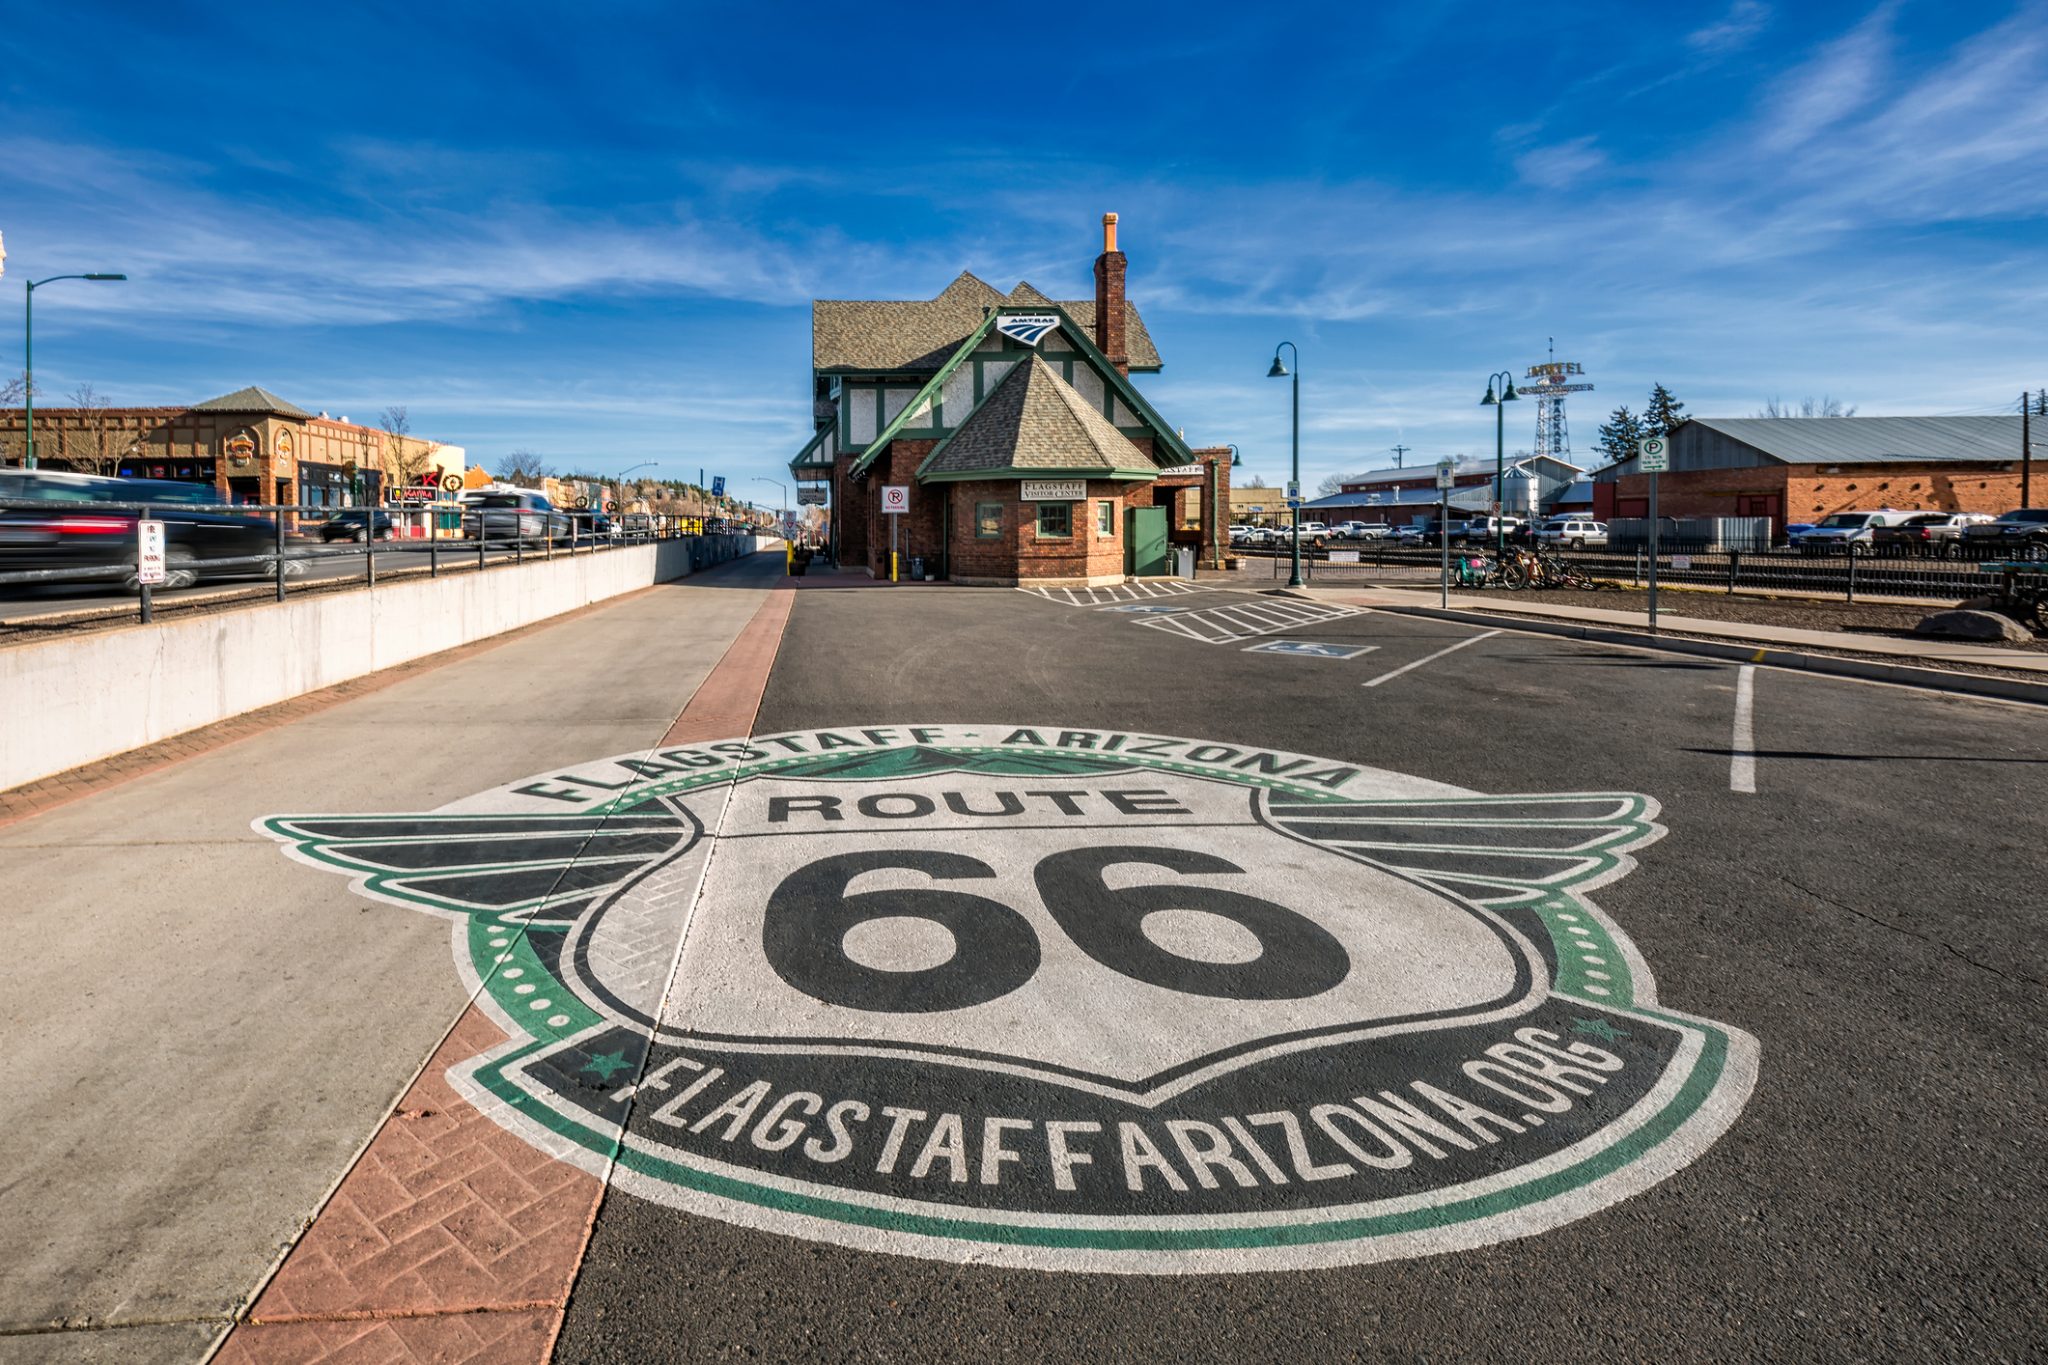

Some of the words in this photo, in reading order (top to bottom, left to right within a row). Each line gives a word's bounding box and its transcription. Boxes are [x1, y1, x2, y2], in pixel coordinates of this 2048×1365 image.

[1649, 442, 1658, 451] P
[1024, 482, 1082, 490] FLAGSTAFF
[1024, 490, 1053, 498] VISITOR
[510, 727, 945, 803] FLAGSTAFF
[1001, 729, 1362, 789] ARIZONA
[768, 790, 1193, 822] ROUTE
[762, 846, 1351, 1013] 66
[610, 1027, 1625, 1192] FLAGSTAFFARIZONA.ORG
